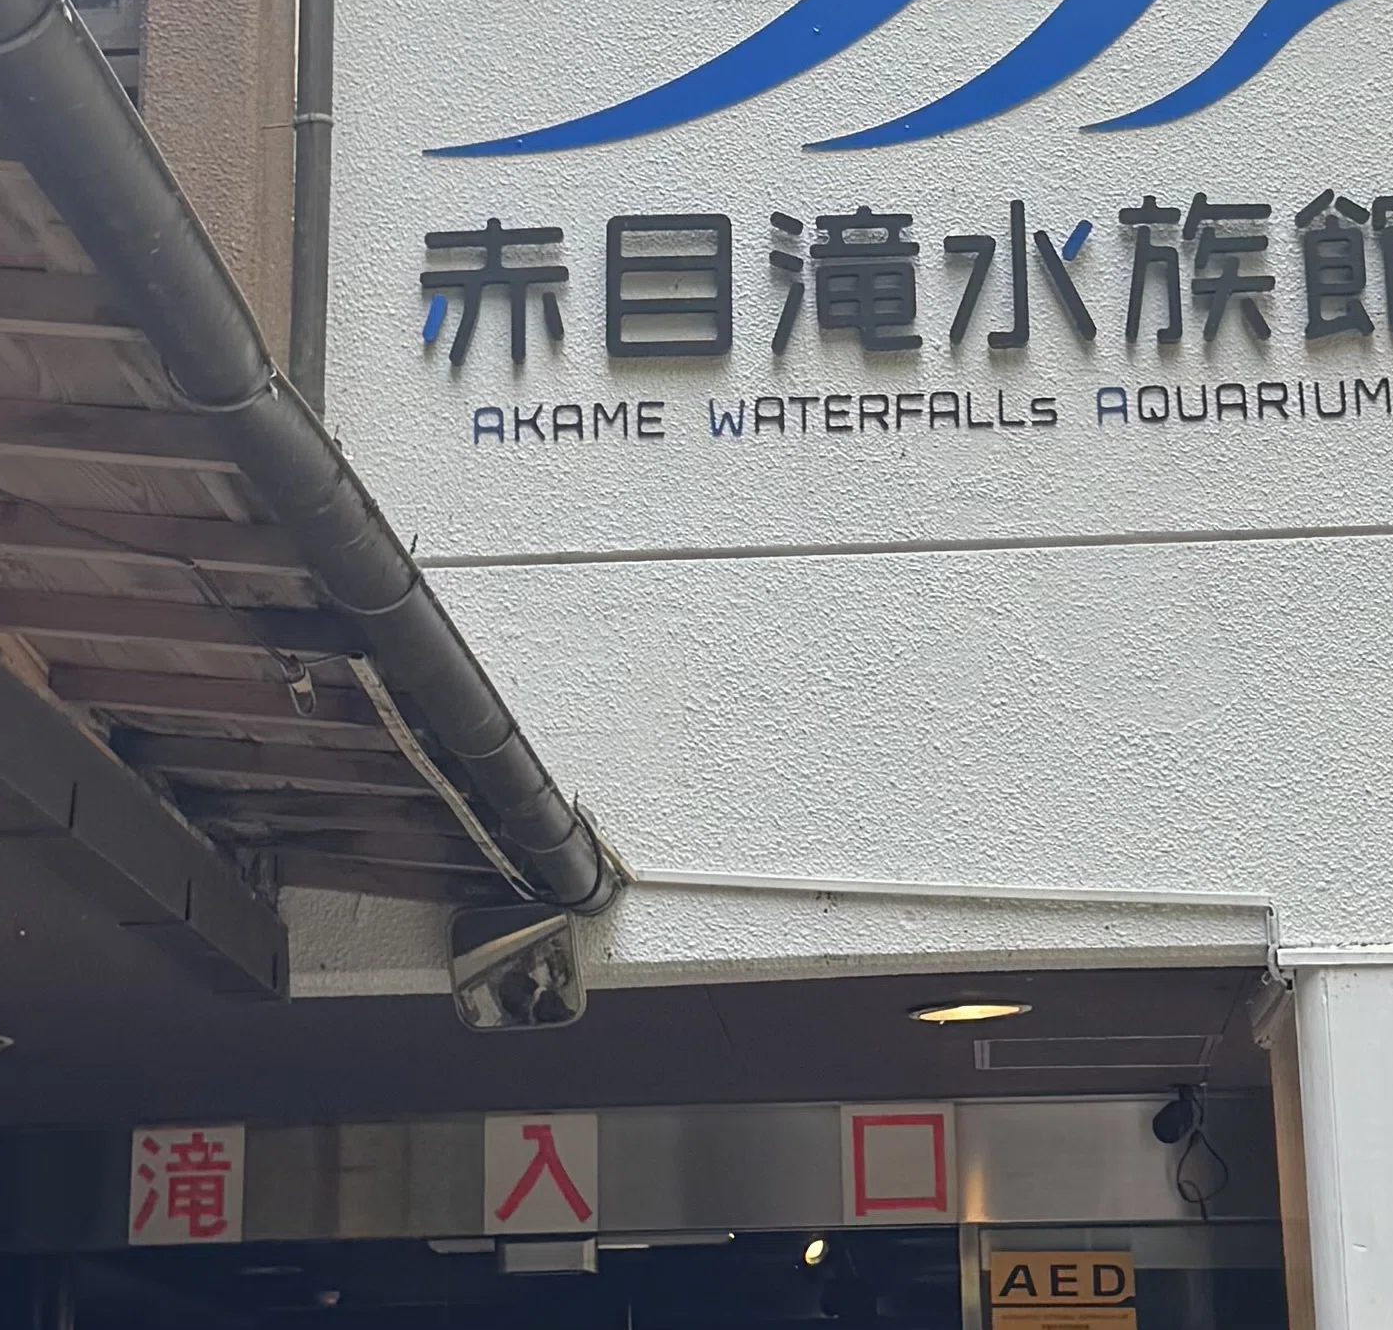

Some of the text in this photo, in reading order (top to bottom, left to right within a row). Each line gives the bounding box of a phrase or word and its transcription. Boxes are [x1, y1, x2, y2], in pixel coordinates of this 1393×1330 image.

[474, 401, 665, 443] AKAME
[1096, 377, 1392, 425] AQUARIUM
[998, 1264, 1126, 1297] AED
